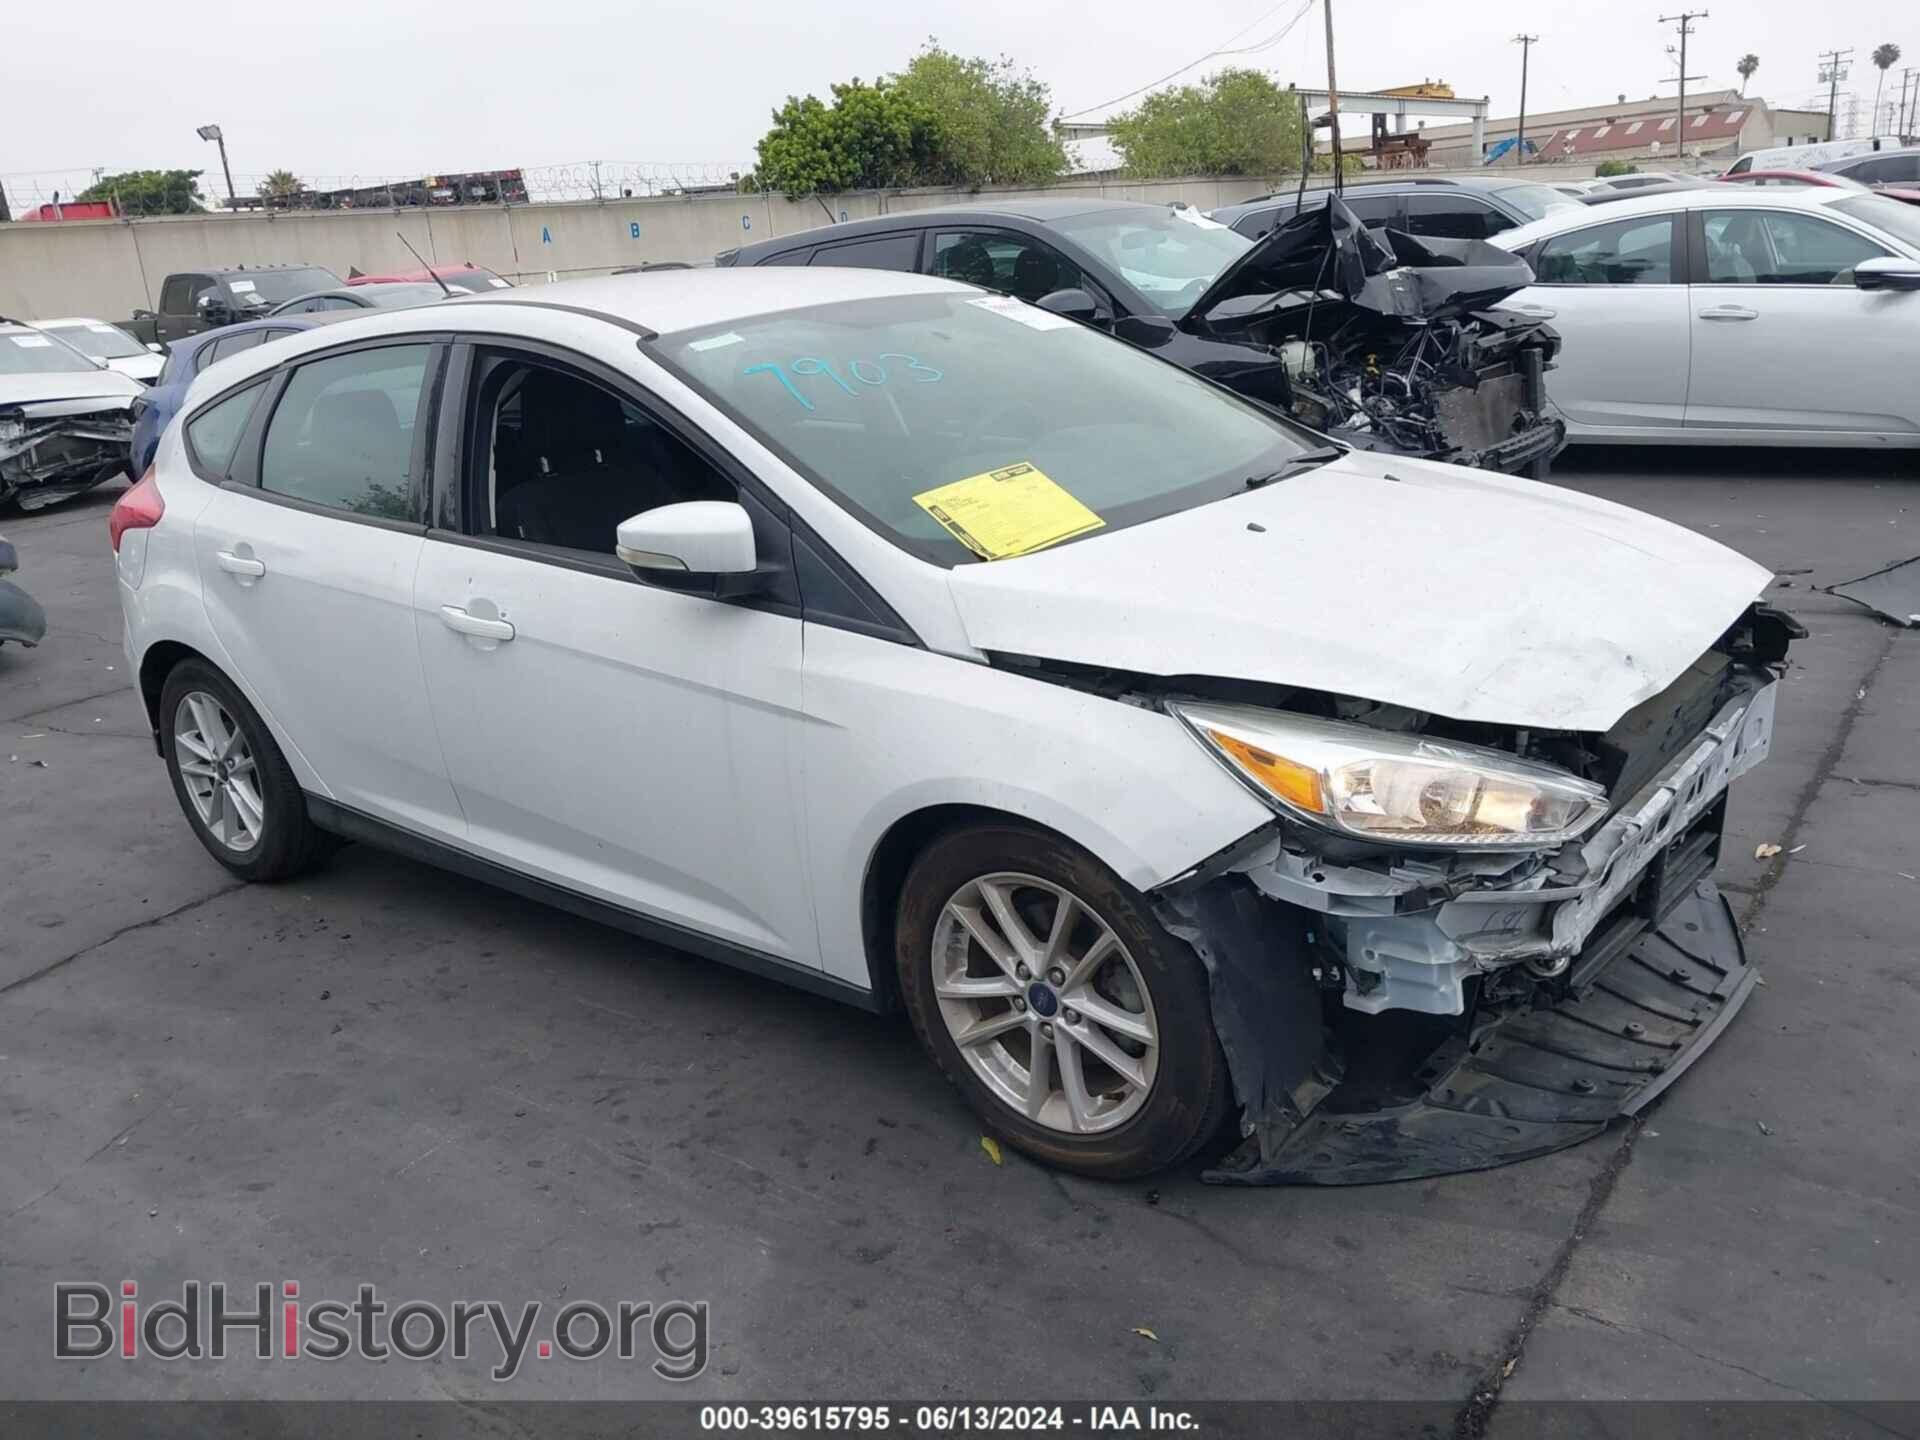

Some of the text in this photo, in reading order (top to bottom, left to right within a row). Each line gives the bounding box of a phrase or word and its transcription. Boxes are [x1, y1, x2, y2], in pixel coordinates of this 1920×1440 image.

[629, 221, 641, 239] B
[742, 215, 752, 231] C
[542, 226, 553, 244] A
[743, 353, 945, 411] 7903
